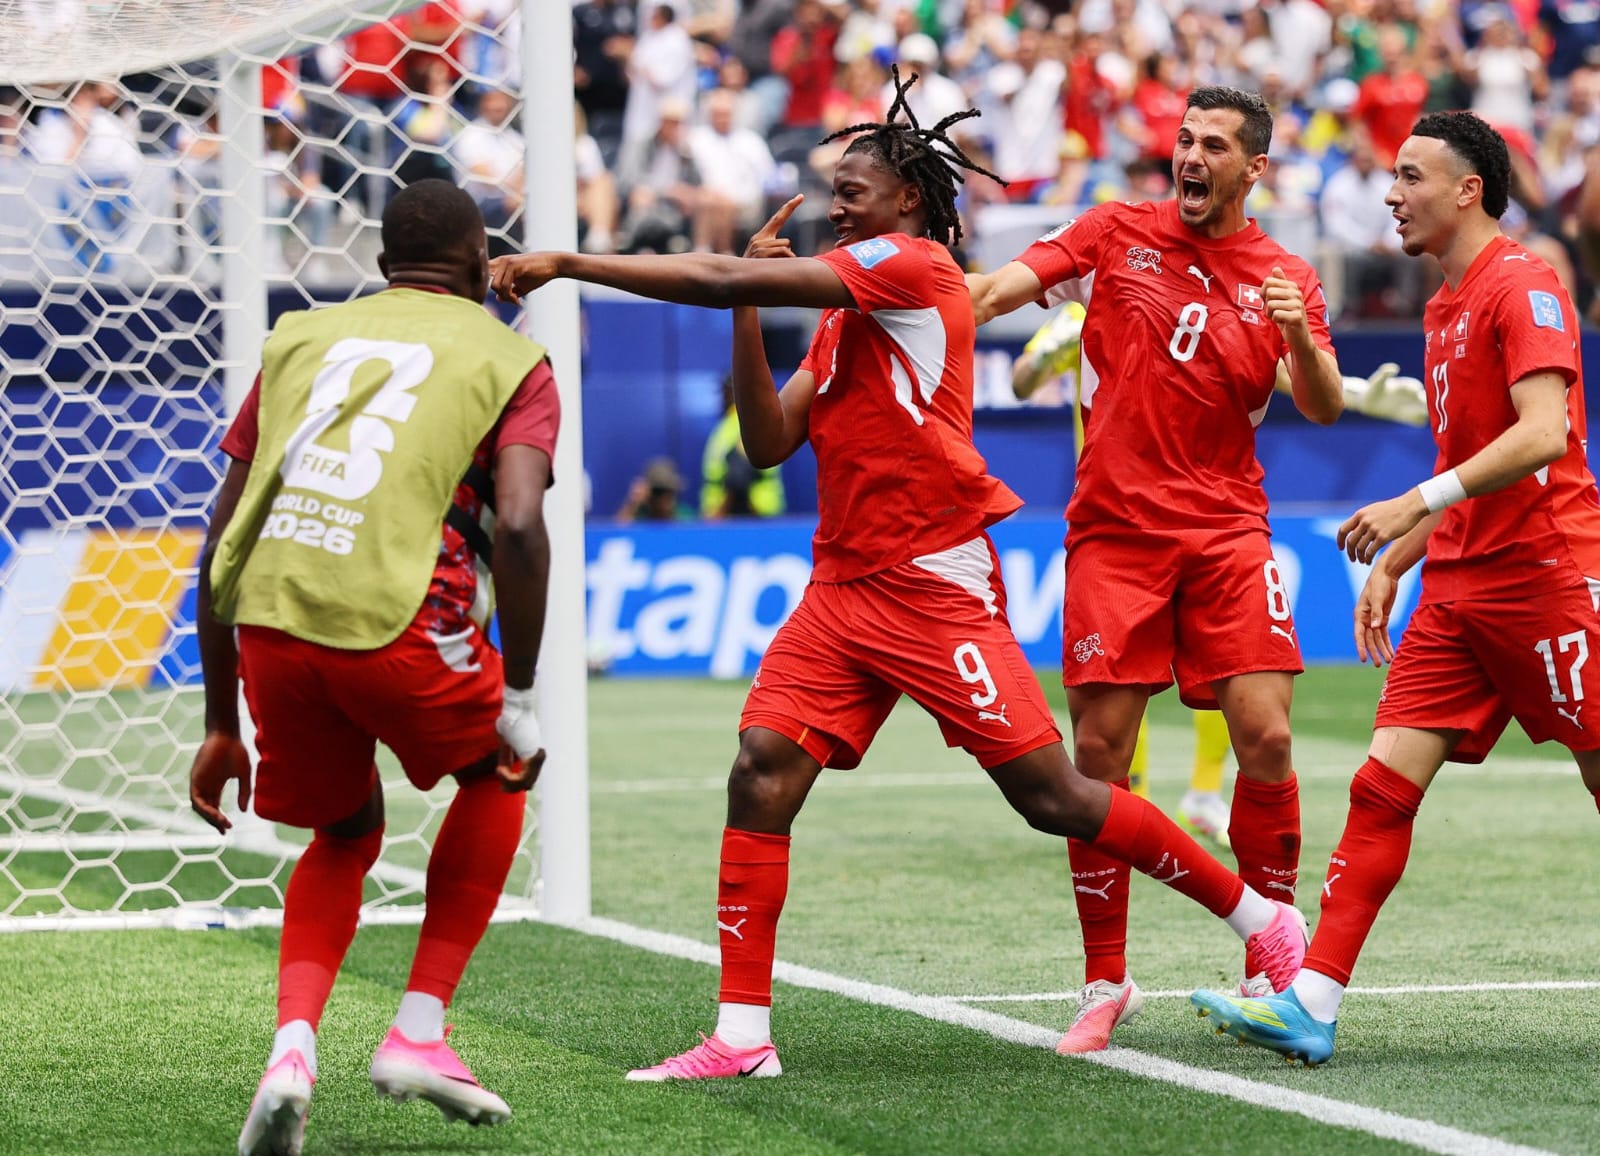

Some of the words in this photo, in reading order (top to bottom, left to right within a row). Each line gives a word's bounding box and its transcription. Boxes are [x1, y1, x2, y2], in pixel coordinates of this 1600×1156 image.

[1169, 301, 1208, 362] 8
[1432, 360, 1449, 434] 17
[299, 453, 346, 481] FIFA
[259, 512, 356, 556] 2026
[272, 493, 321, 516] ORLD
[322, 502, 365, 528] CUP
[1263, 559, 1290, 621] 8
[953, 641, 998, 708] 9
[1534, 629, 1589, 702] 17
